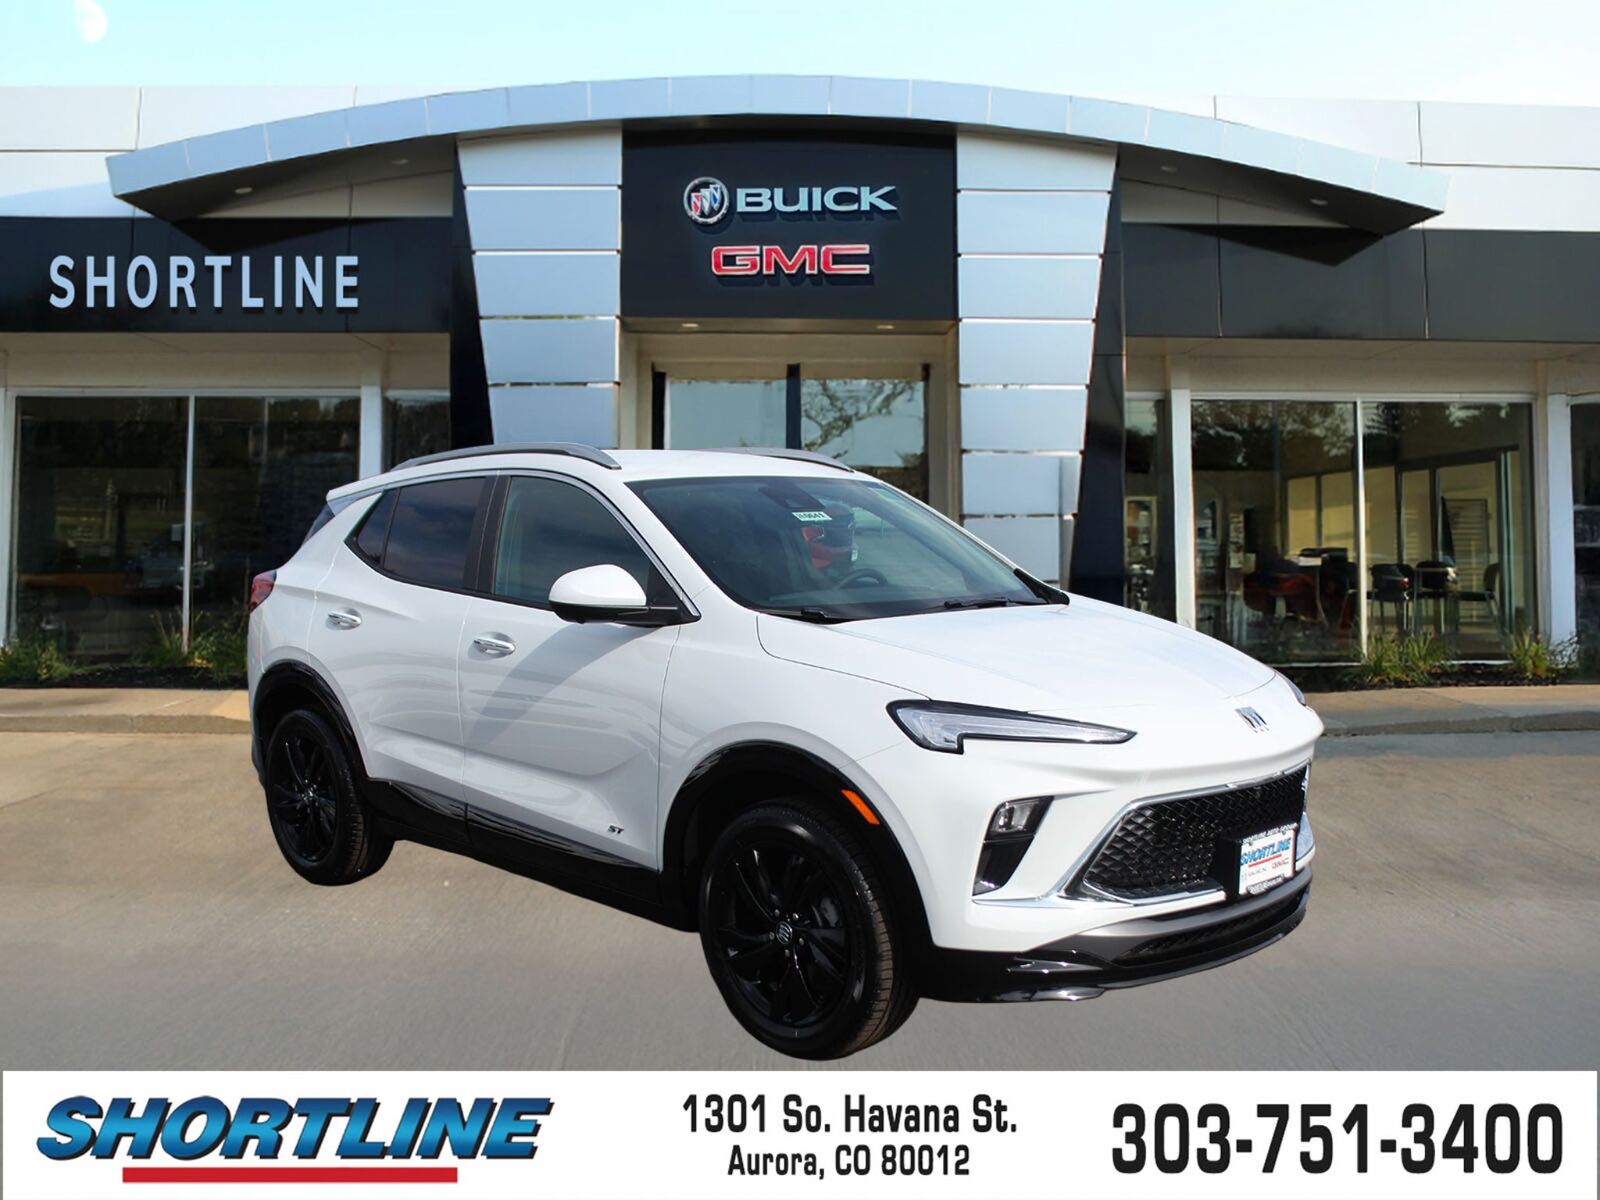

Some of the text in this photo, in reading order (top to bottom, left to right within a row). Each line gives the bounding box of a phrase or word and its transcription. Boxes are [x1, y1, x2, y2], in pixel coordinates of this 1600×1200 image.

[736, 186, 898, 213] BUICK
[711, 244, 870, 275] GMC
[49, 255, 359, 308] SHORTLINE
[608, 825, 625, 834] ST
[1240, 838, 1291, 865] SHORTLINE
